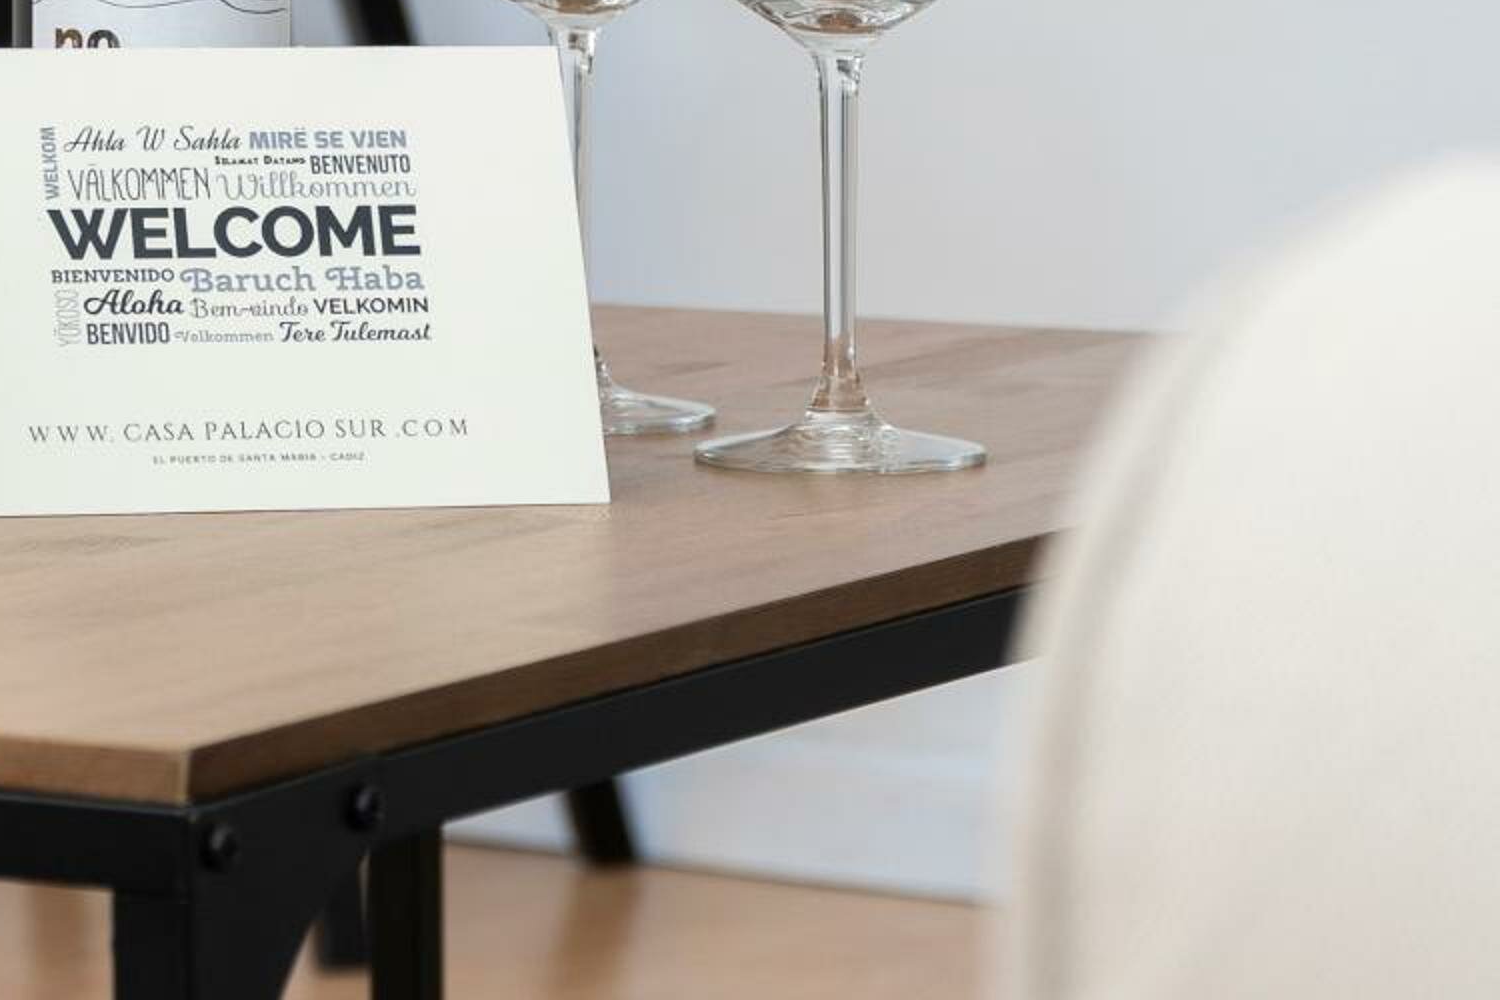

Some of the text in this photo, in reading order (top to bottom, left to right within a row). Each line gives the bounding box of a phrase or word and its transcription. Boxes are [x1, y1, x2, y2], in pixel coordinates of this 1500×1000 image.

[64, 126, 242, 152] Ahla W Sahla
[249, 127, 407, 150] MIRË SE VJEN
[40, 126, 60, 200] WELKOM
[310, 154, 410, 174] BENVENUTO
[216, 169, 416, 200] Willkommen
[46, 204, 421, 260] WELCOME
[51, 268, 174, 284] BIENVENIDO
[179, 264, 425, 293] Baruch Haba
[84, 289, 184, 315] Aloha
[313, 297, 428, 314] VELKOMIN
[86, 322, 170, 345] BENVIDO
[279, 320, 430, 342] Tere Tulemast
[123, 423, 194, 442] CASA
[205, 419, 324, 440] PALACIO
[335, 419, 386, 438] SUR
[153, 456, 165, 465] EL
[170, 455, 216, 464] PUERTO
[219, 454, 233, 463] DE
[238, 454, 276, 462] SANTA
